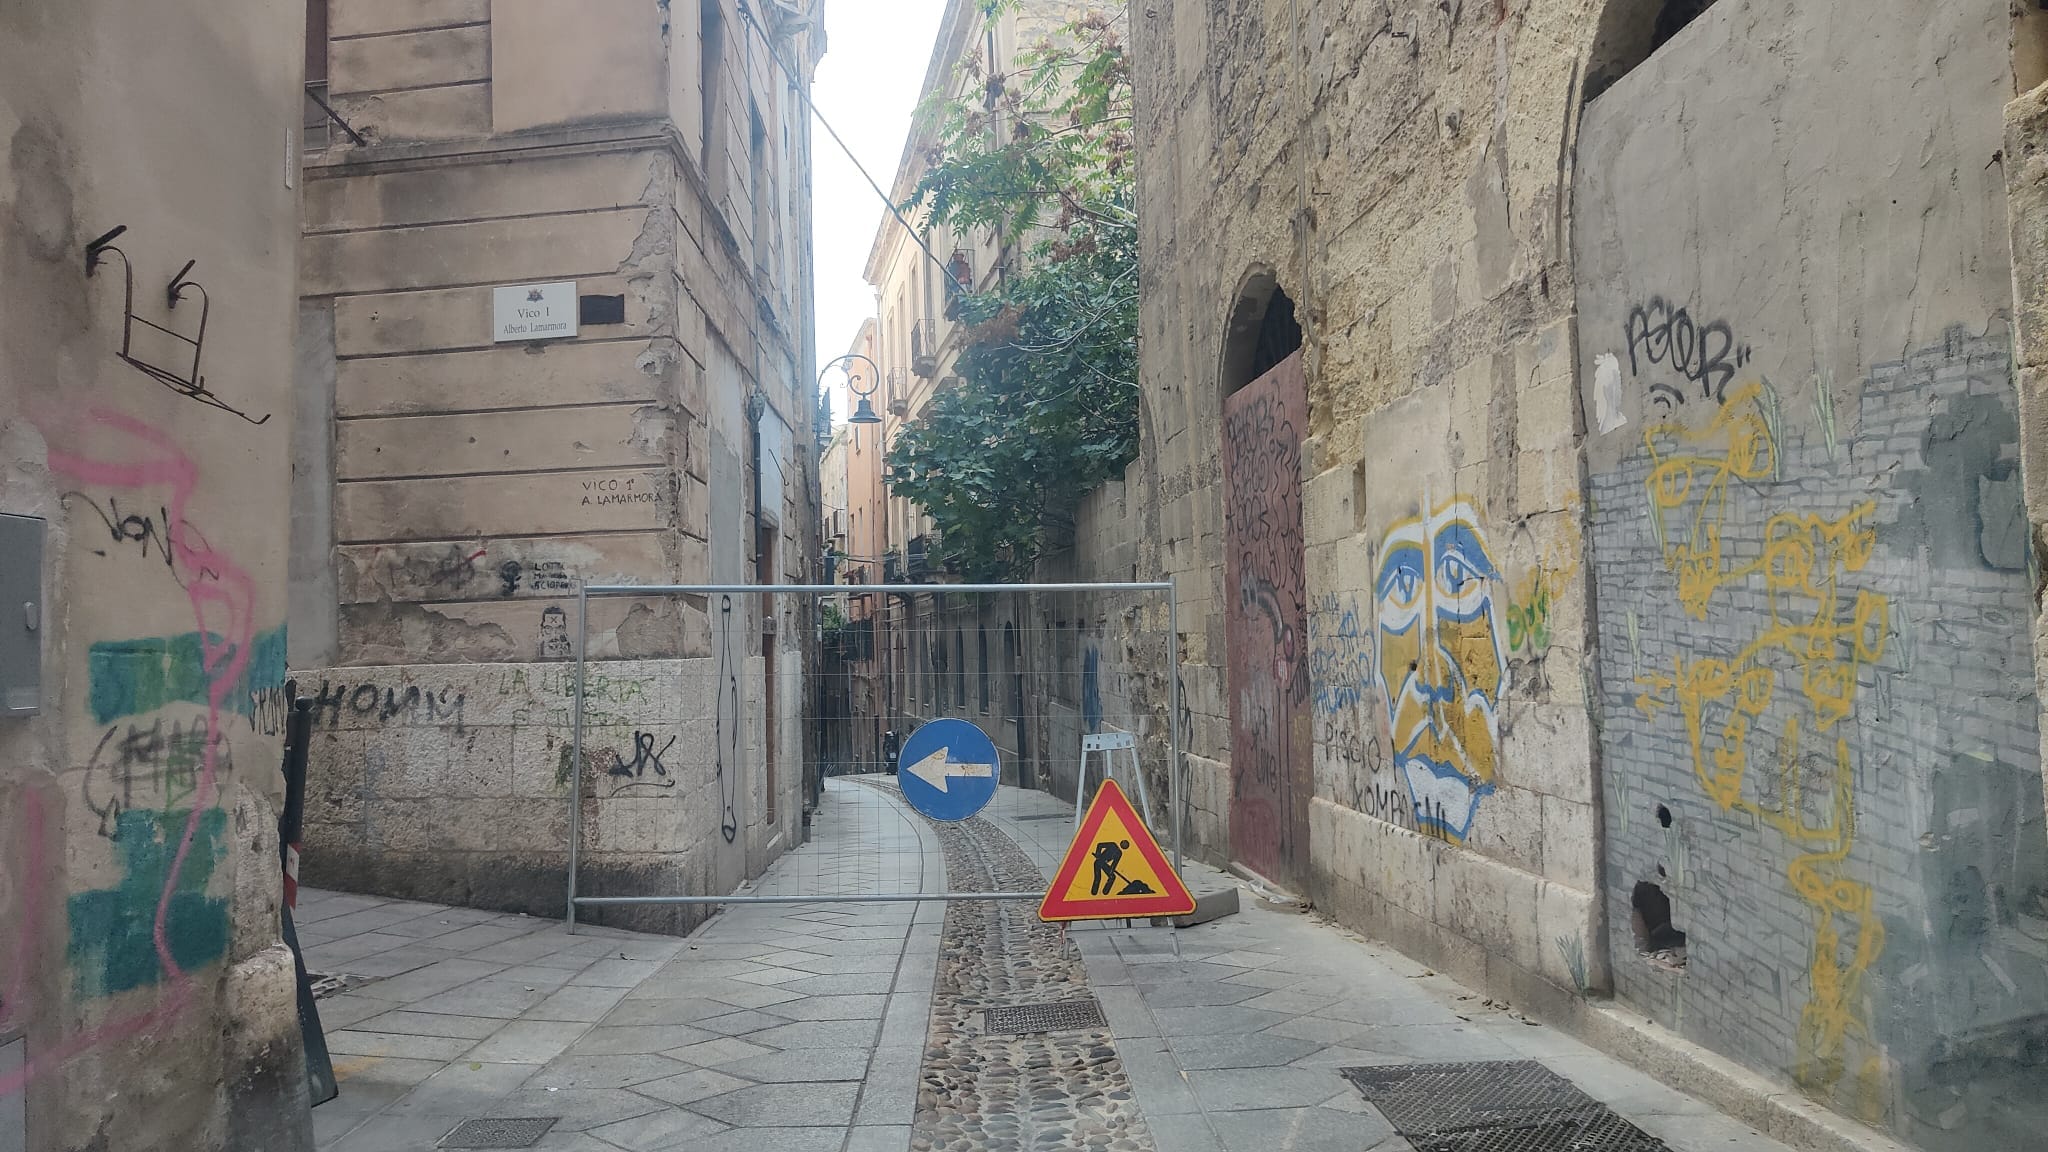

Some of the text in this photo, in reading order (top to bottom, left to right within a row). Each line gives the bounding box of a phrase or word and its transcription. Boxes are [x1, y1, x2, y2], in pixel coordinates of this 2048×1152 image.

[517, 308, 540, 319] Vico
[503, 321, 567, 335] Alberto Lamarmora
[582, 479, 618, 491] VICO
[597, 492, 663, 506] LAMARMORA
[498, 668, 530, 696] LA
